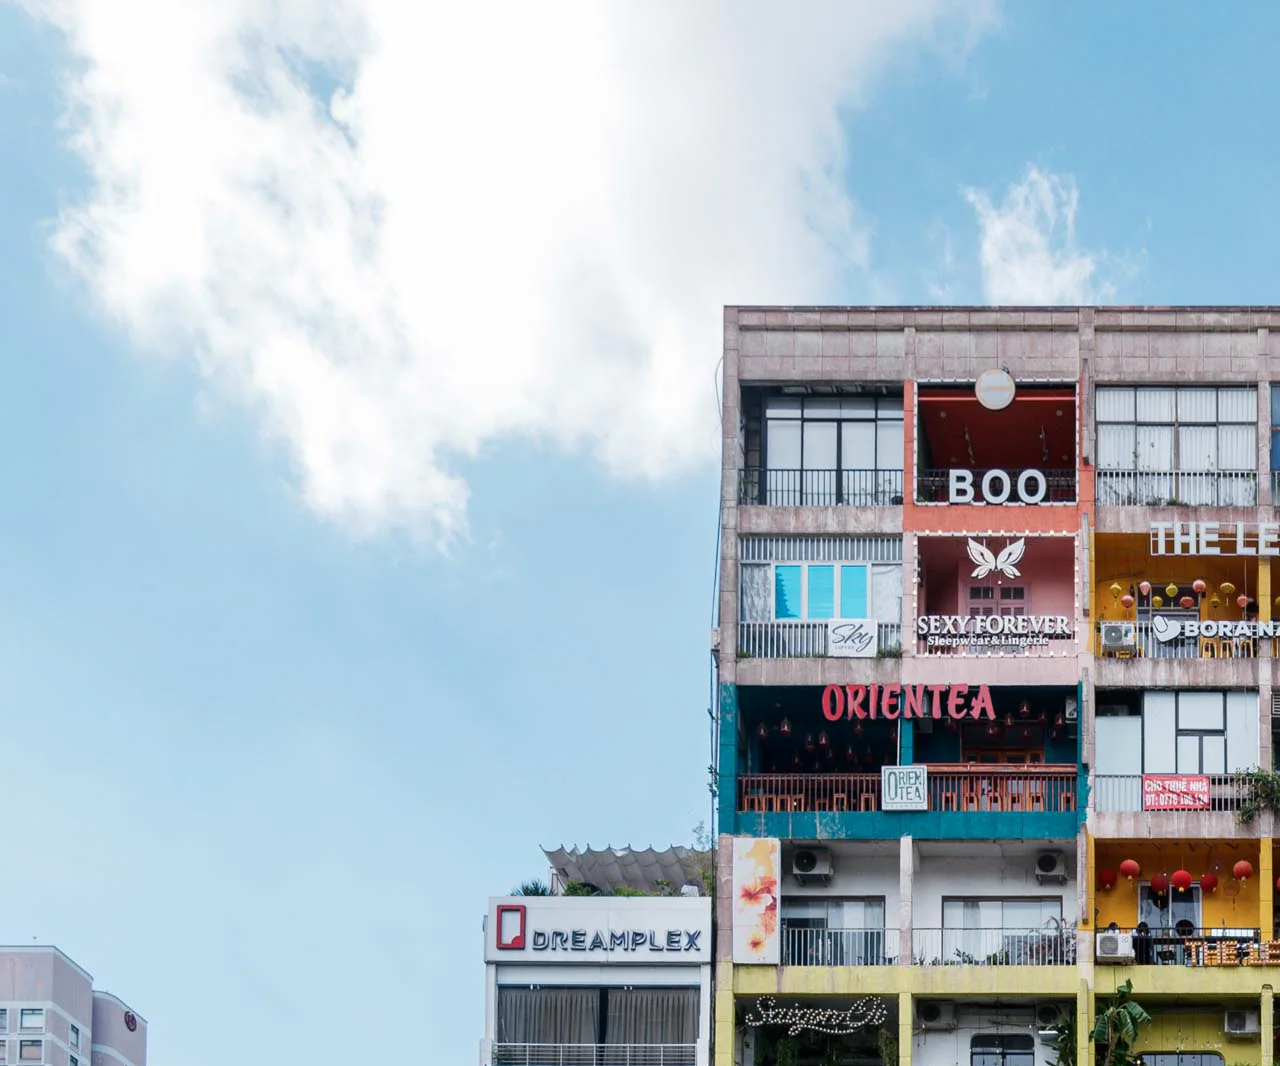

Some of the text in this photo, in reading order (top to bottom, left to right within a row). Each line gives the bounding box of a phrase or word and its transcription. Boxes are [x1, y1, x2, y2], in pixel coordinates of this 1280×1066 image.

[949, 469, 1047, 504] BOO
[1151, 521, 1220, 556] THE
[832, 624, 873, 653] Sky
[918, 616, 1071, 635] SEXY FOREVER
[1187, 621, 1251, 637] BORA
[822, 682, 996, 721] ORIENTEA
[532, 930, 701, 951] DREAMPLEX
[1185, 940, 1239, 967] THE
